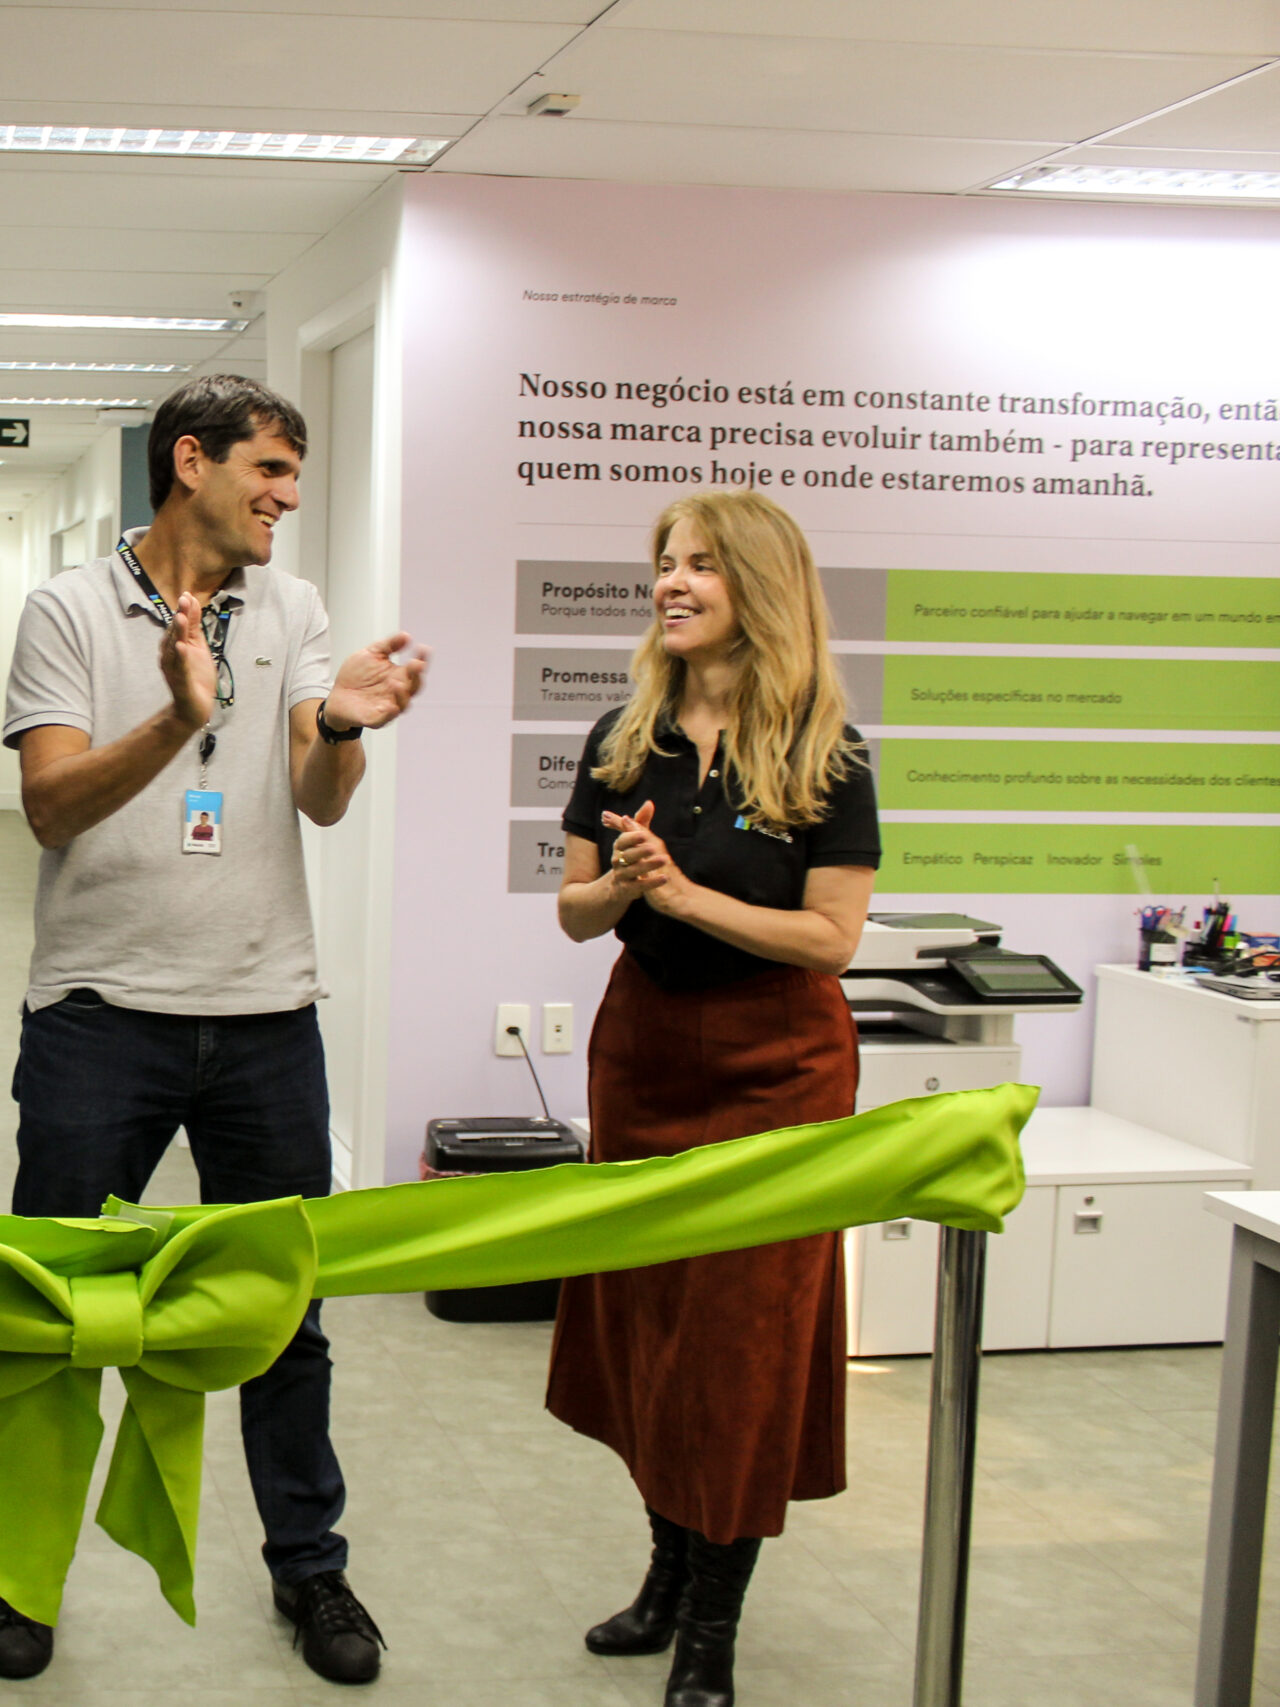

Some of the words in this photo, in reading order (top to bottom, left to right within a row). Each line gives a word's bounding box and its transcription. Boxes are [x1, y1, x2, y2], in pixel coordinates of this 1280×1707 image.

[522, 290, 559, 301] Nossa
[562, 292, 620, 306] estratégia
[623, 293, 638, 304] de
[641, 296, 678, 306] marca
[518, 373, 607, 399] Nosso
[616, 376, 729, 408] negócio
[738, 380, 795, 405] está
[803, 387, 845, 407] em
[855, 389, 990, 412] constante
[998, 392, 1210, 426] transformação,
[518, 418, 602, 440] nossa
[611, 421, 702, 443] marca
[710, 422, 814, 451] precisa
[822, 425, 922, 450] evoluir
[929, 429, 1044, 454] também
[1070, 437, 1133, 462] para
[517, 459, 601, 486] quem
[610, 462, 703, 484] somos
[710, 459, 773, 490] hoje
[780, 468, 796, 486] e
[804, 465, 874, 489] onde
[881, 470, 1025, 493] estaremos
[1033, 473, 1153, 497] amanhã.
[121, 550, 141, 576] MetLife
[542, 582, 629, 601] Propósito
[541, 603, 587, 618] Porque
[590, 605, 627, 617] todos
[631, 605, 652, 618] nós
[914, 603, 968, 617] Parceiro
[1032, 608, 1060, 621] para
[1064, 607, 1104, 622] ajudar
[1107, 611, 1115, 621] a
[1118, 611, 1169, 624] navegar
[1172, 612, 1192, 622] em
[1195, 613, 1215, 622] um
[1218, 611, 1262, 623] mundo
[542, 668, 629, 684] Promessa
[541, 689, 602, 702] Trazemos
[911, 688, 969, 704] Soluções
[1046, 691, 1062, 702] no
[1066, 691, 1122, 704] mercado
[906, 769, 1000, 783] Conhecimento
[1004, 771, 1062, 785] profundo
[1066, 772, 1101, 785] sobre
[1105, 776, 1119, 785] as
[1122, 774, 1206, 786] necessidades
[1209, 774, 1231, 786] dos
[536, 842, 565, 857] Tra
[903, 851, 963, 867] Empático
[974, 852, 1034, 867] Perspicaz
[1047, 853, 1102, 866] Inovador
